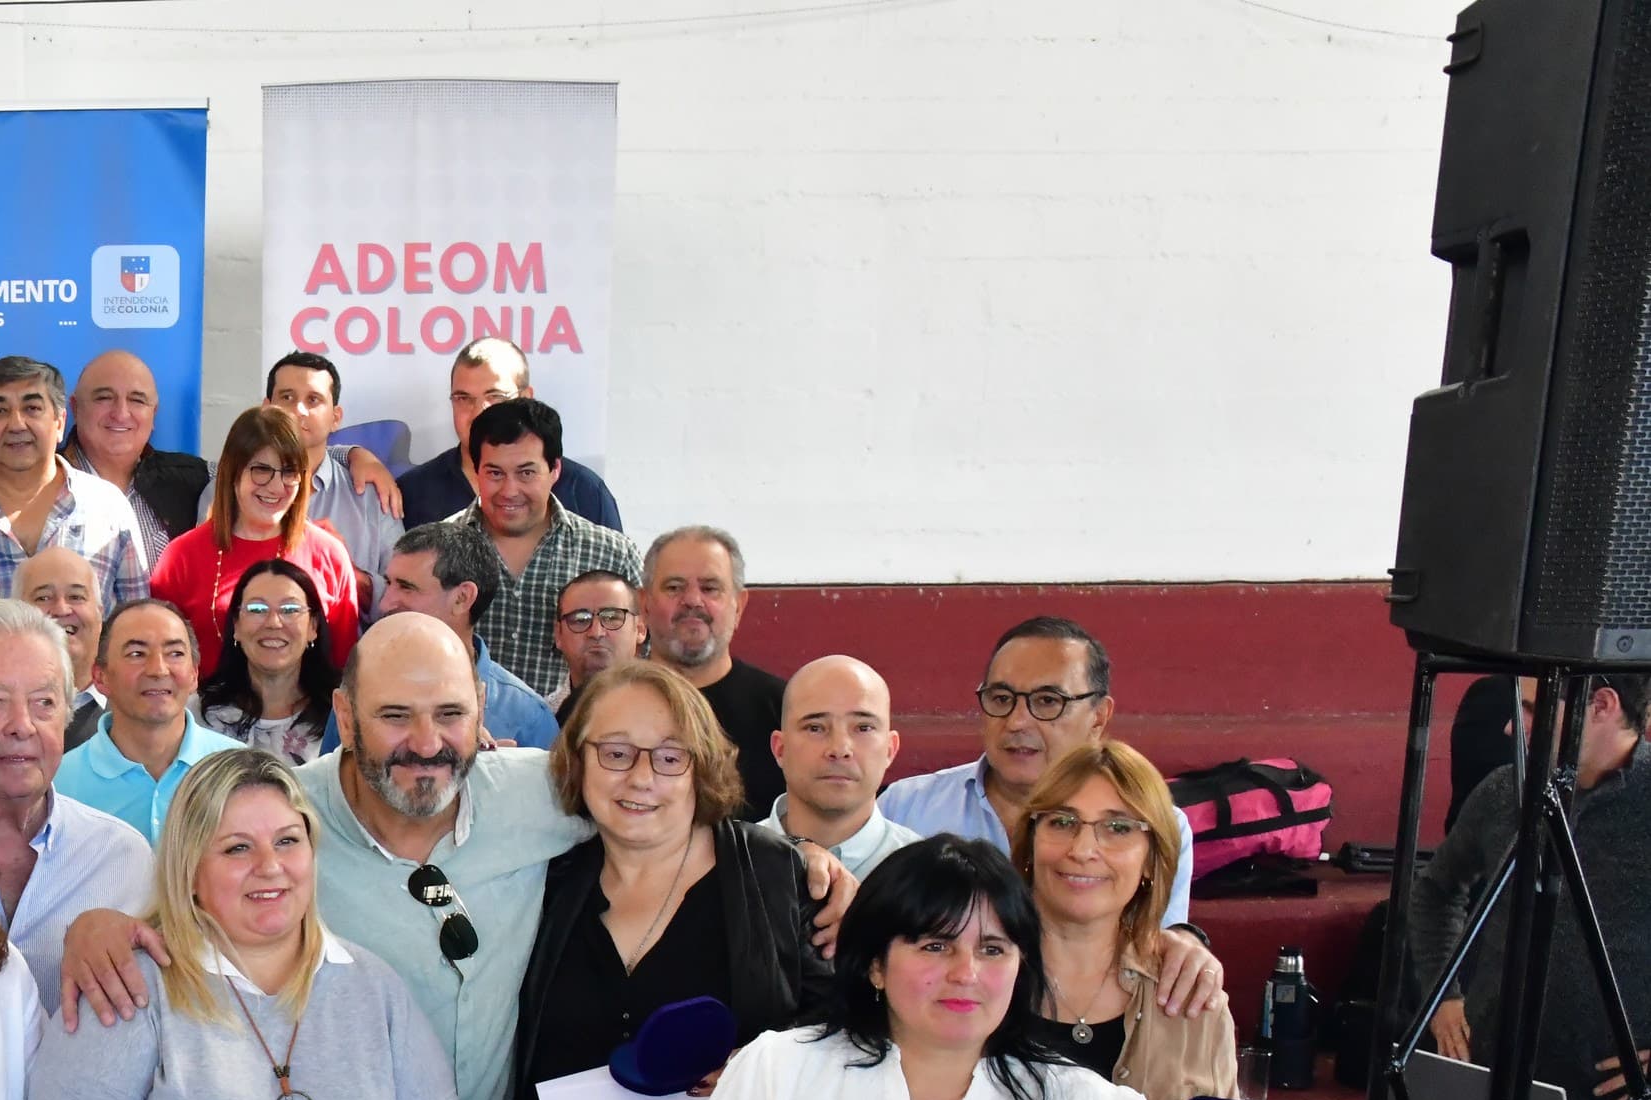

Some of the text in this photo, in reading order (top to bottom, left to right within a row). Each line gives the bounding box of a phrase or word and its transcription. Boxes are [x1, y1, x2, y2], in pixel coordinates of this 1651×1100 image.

[304, 241, 547, 294] ADEOM
[103, 296, 168, 305] INTENDENCIA
[290, 305, 583, 355] COLONIA
